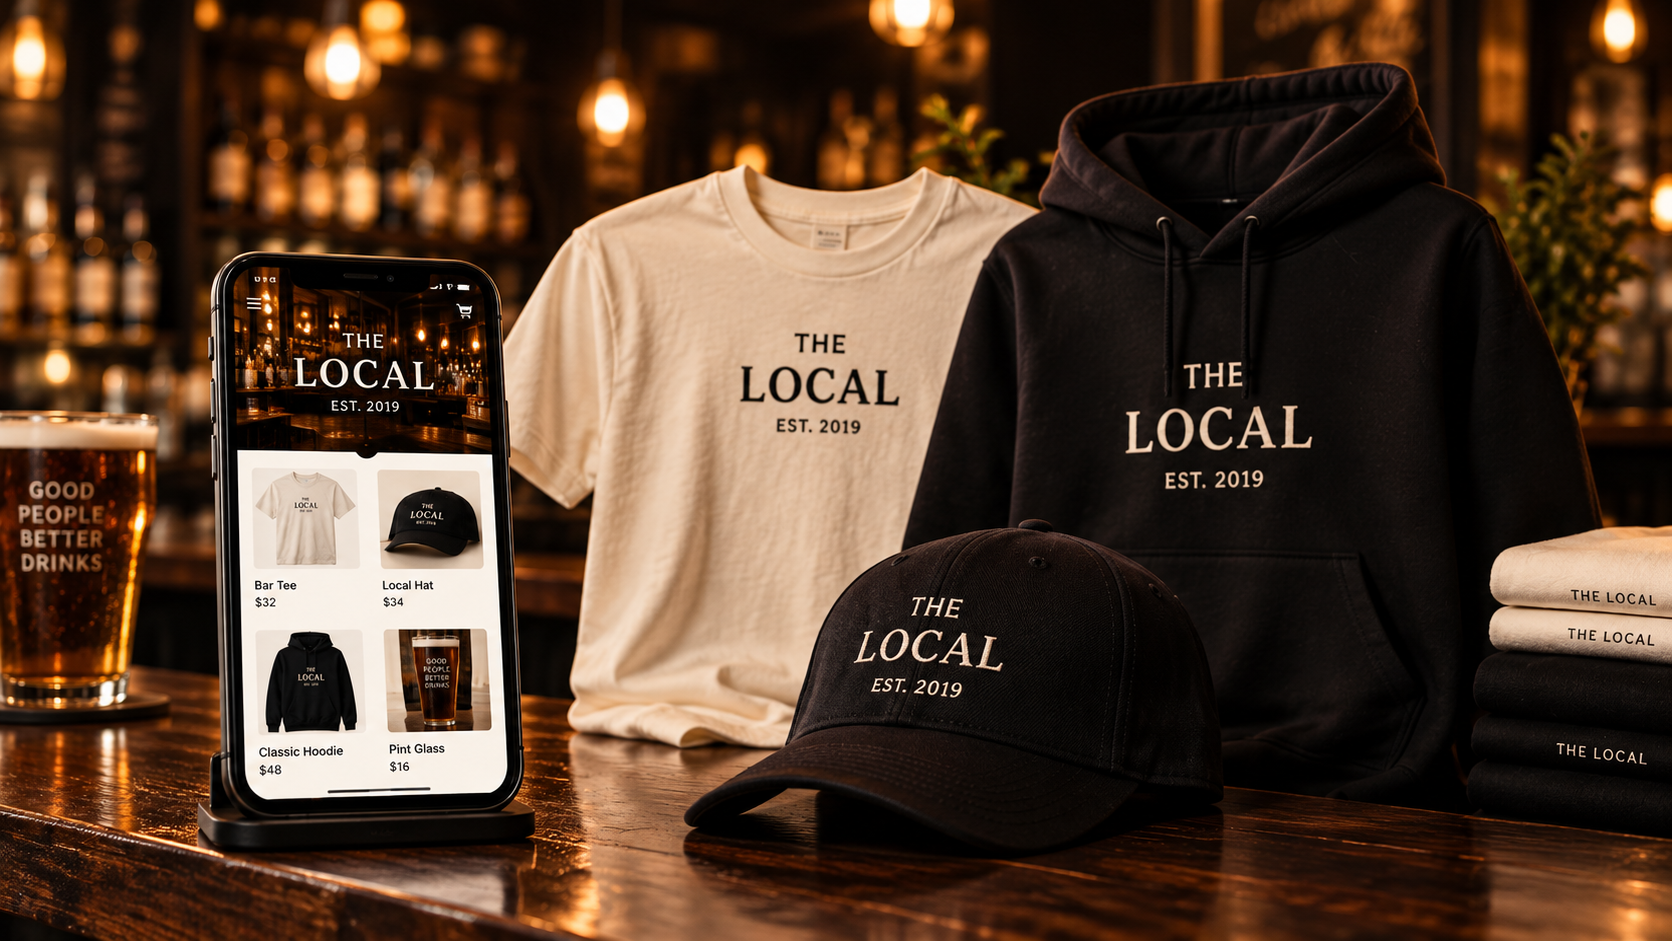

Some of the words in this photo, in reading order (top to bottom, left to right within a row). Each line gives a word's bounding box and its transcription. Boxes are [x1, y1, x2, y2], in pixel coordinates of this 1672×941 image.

[342, 333, 384, 349] THE
[794, 333, 846, 354] THE
[294, 357, 434, 390] LOCAL
[1183, 361, 1243, 389] THE
[740, 366, 900, 406] LOCAL
[331, 400, 361, 412] EST.
[366, 400, 399, 413] 2019
[776, 418, 813, 433] EST.
[819, 419, 861, 434] 2019
[1125, 405, 1313, 454] LOCAL
[1165, 471, 1206, 490] EST.
[1214, 469, 1264, 489] 2019
[29, 480, 95, 500] GOOD
[18, 504, 105, 525] PEOPLE
[410, 510, 444, 520] LOCAL
[20, 529, 104, 548] BETTER
[21, 553, 103, 573] DRINKS
[254, 580, 274, 590] Bar
[277, 580, 297, 590] Tee
[382, 580, 412, 590] Local
[415, 580, 434, 590] Hat
[255, 597, 276, 608] $32
[383, 597, 404, 608] $34
[1570, 589, 1600, 602] THE
[1606, 592, 1657, 606] LOCAL
[911, 597, 964, 619] THE
[1567, 628, 1597, 641] THE
[1603, 631, 1655, 647] LOCAL
[853, 628, 1003, 672] LOCAL
[297, 673, 325, 681] LOCAL
[870, 677, 907, 693] EST.
[913, 679, 963, 698] 2019
[258, 747, 300, 758] Classic
[303, 745, 344, 757] Hoodie
[389, 744, 411, 755] Pint
[414, 743, 445, 754] Glass
[1556, 742, 1587, 758] THE
[1593, 747, 1648, 766] LOCAL
[259, 765, 282, 776] $48
[389, 761, 410, 772] $16
